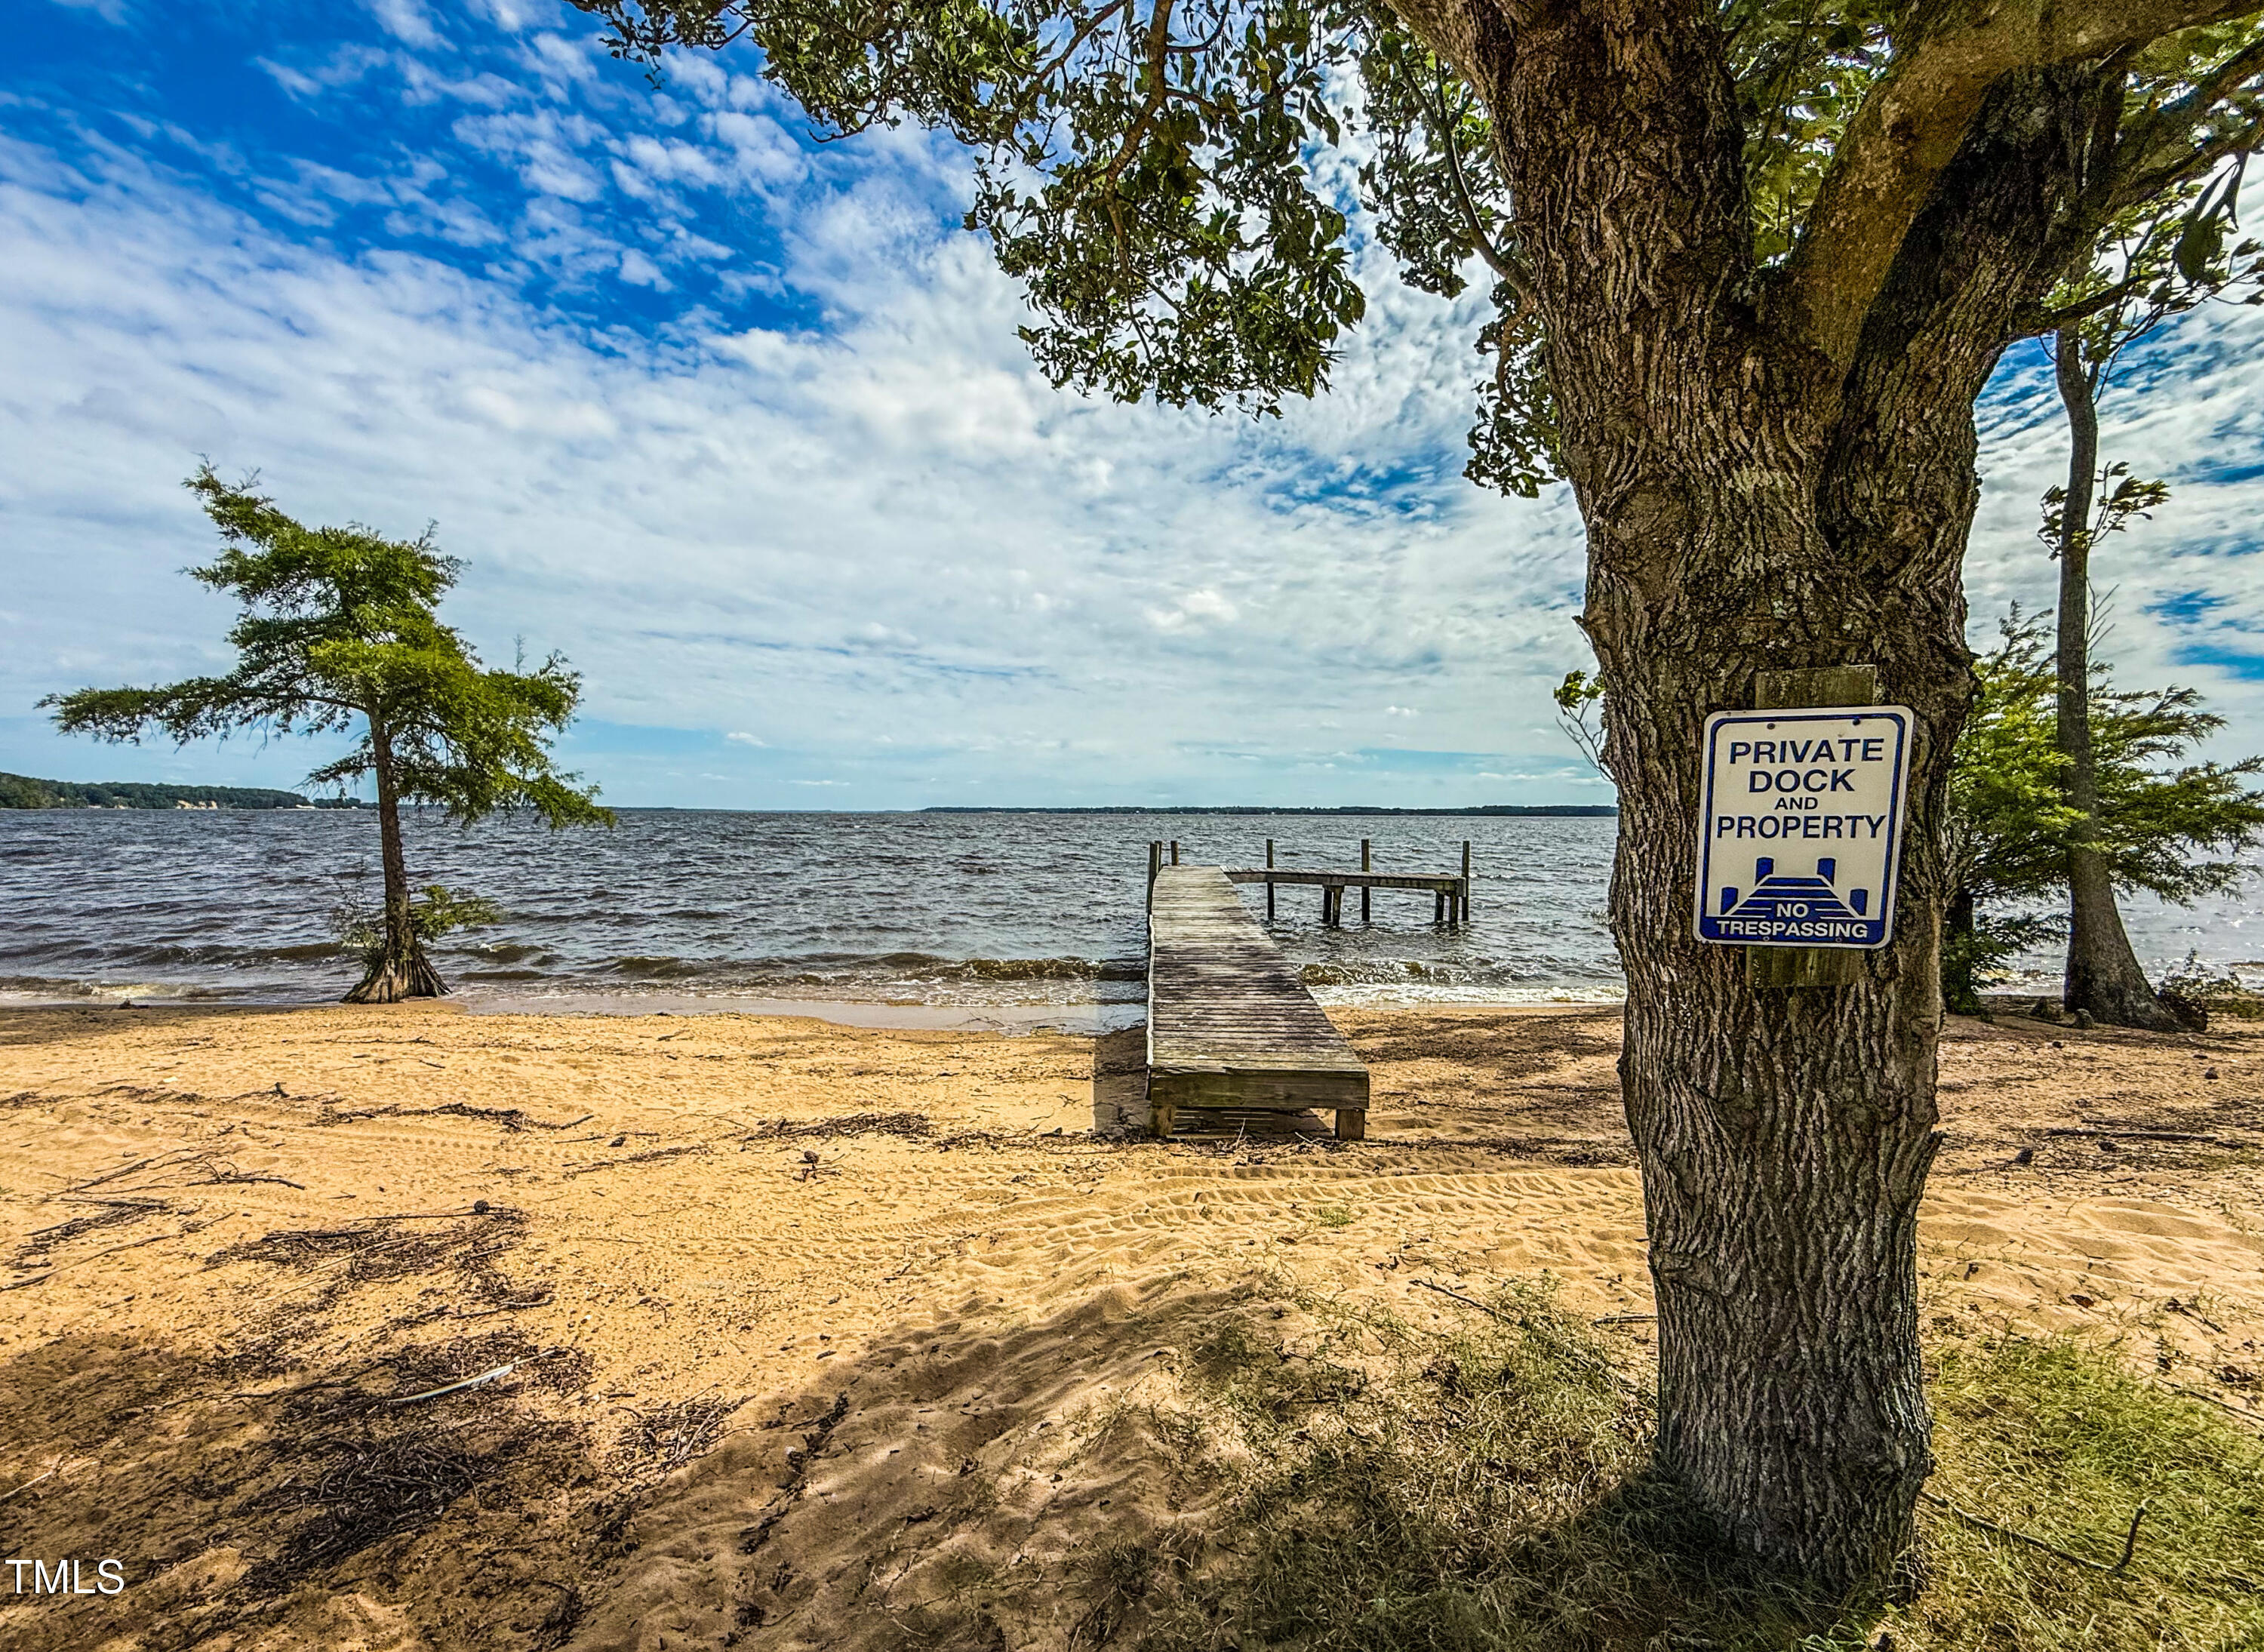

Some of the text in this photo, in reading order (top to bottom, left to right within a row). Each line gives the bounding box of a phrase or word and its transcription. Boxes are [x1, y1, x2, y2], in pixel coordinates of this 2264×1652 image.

[1729, 738, 1885, 764] PRIVATE
[1749, 768, 1856, 793] DOCK
[1774, 797, 1818, 810] AND
[1716, 814, 1887, 839] PROPERTY
[1776, 903, 1809, 918] NO
[1716, 920, 1869, 939] TRESPASSING
